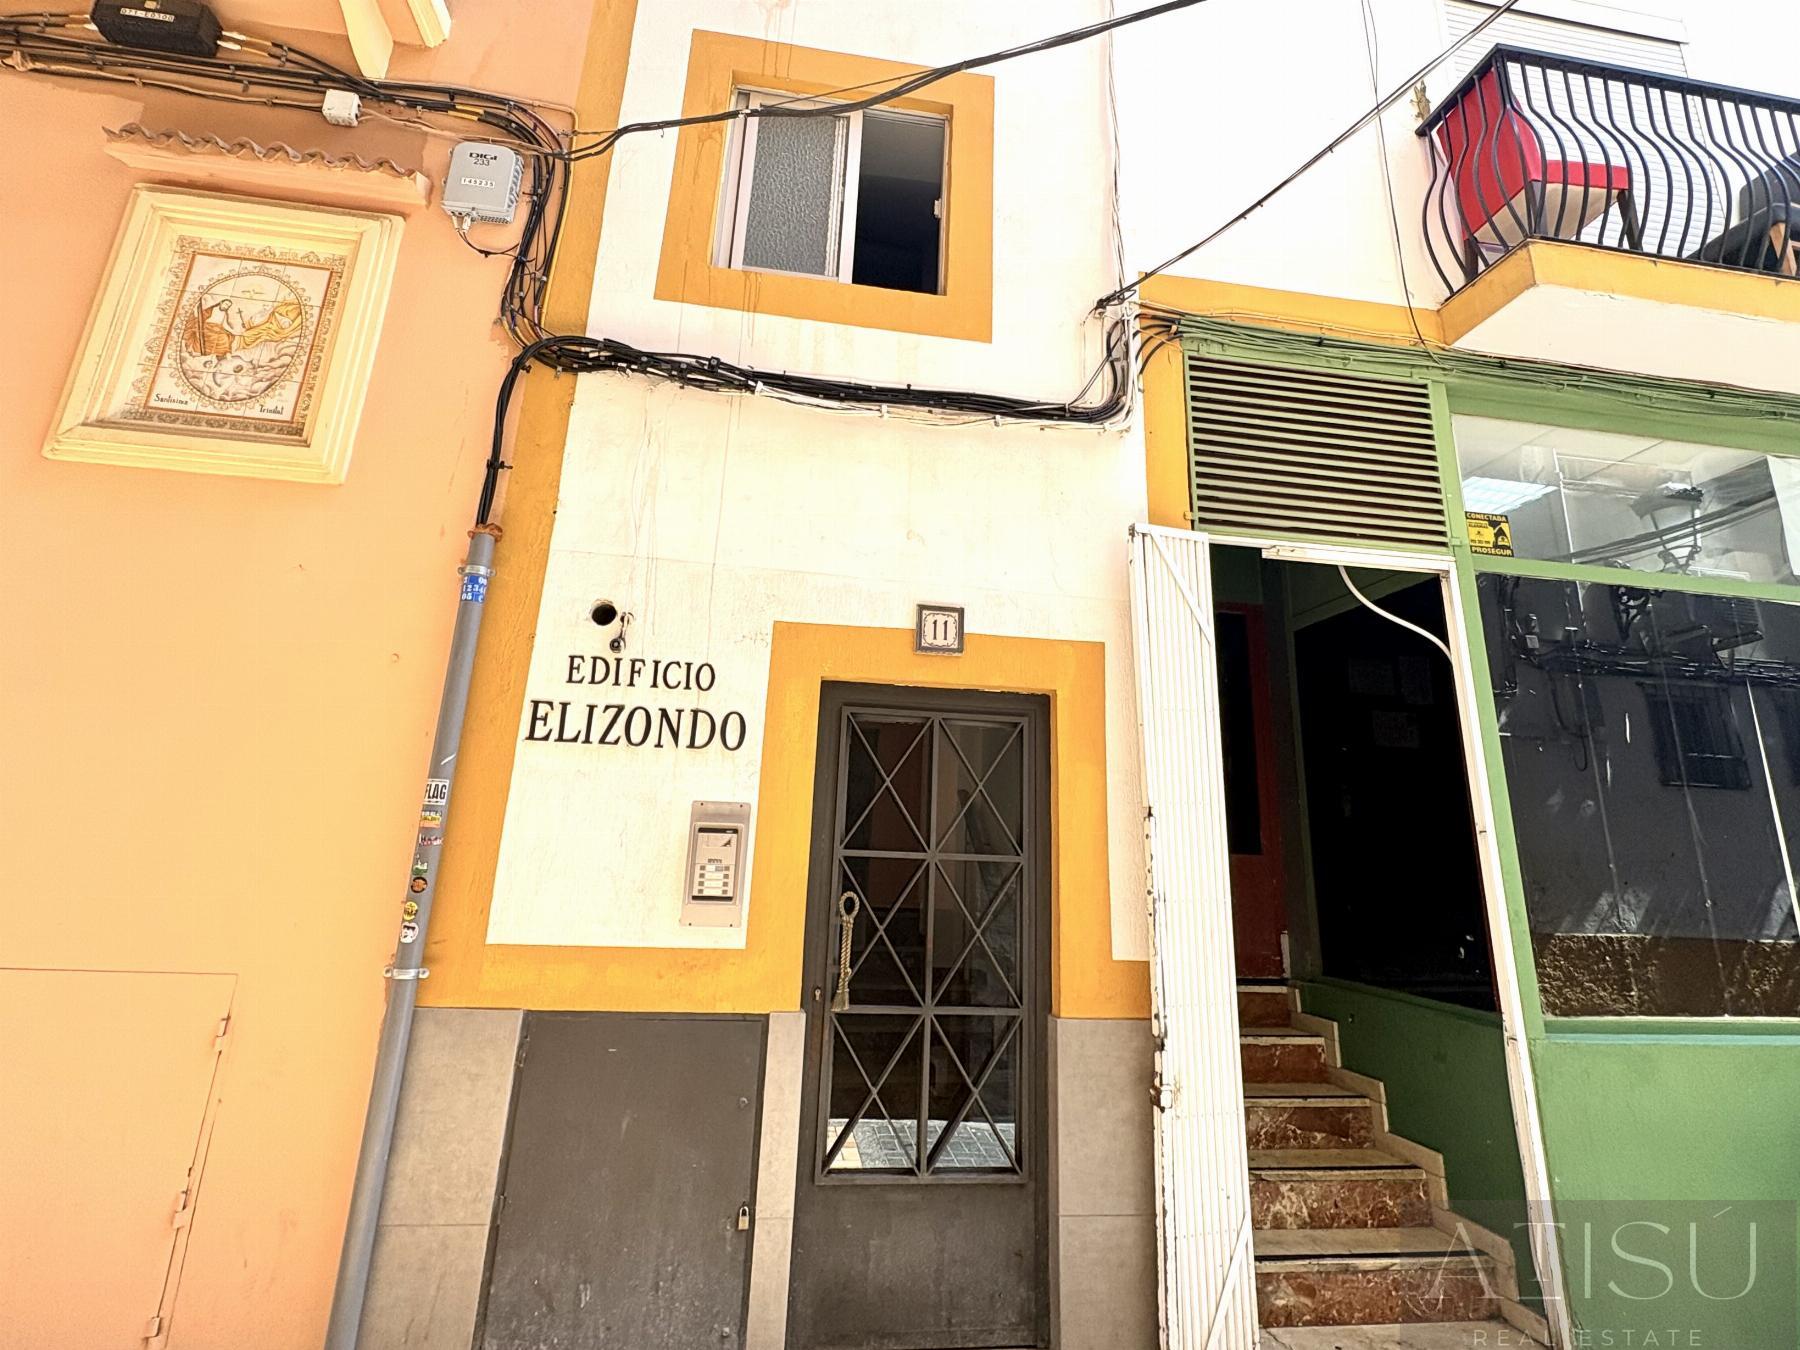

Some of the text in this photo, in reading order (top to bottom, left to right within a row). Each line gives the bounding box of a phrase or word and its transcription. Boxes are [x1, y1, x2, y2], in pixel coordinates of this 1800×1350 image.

[469, 152, 498, 160] DIGI
[1466, 512, 1507, 522] CONECTADA
[1471, 546, 1513, 556] PROSEGUR
[932, 619, 948, 641] 11
[566, 655, 716, 691] EDIFICIO
[525, 700, 746, 751] ELIZONDO
